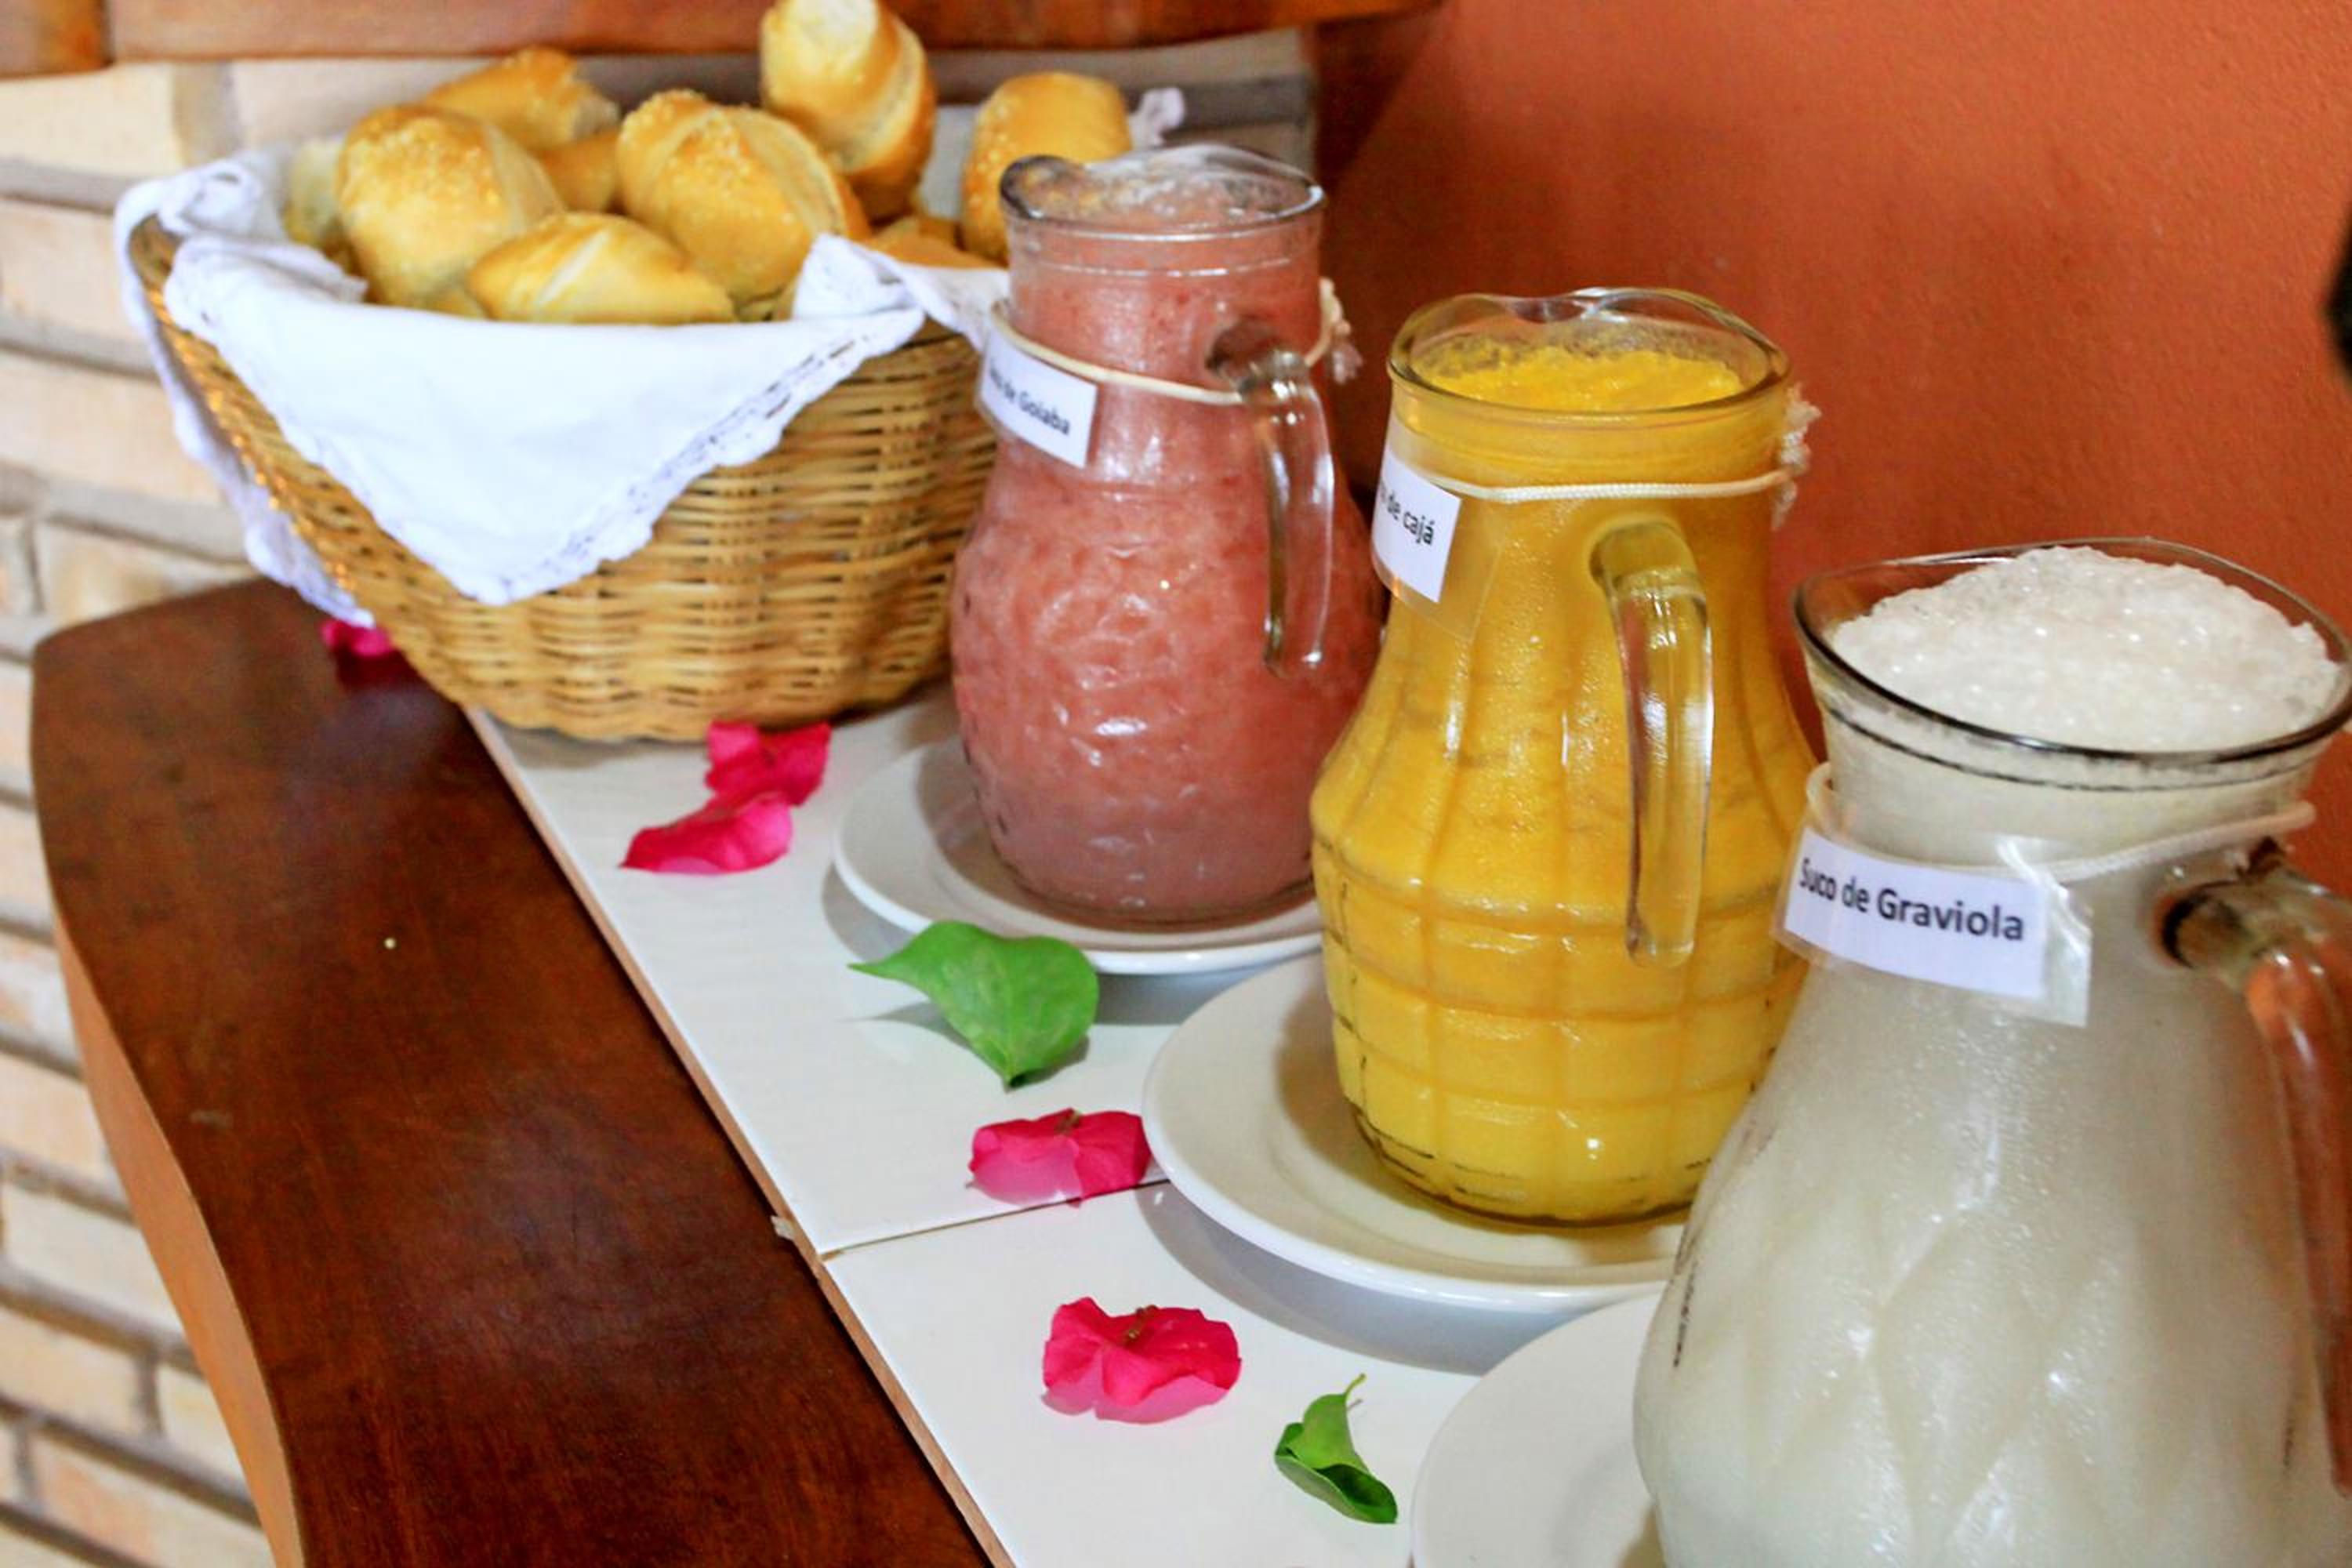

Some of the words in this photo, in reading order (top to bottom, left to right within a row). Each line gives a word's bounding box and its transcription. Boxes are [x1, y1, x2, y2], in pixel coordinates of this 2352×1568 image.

[1020, 391, 1069, 435] Goiaba
[1387, 492, 1401, 521] de
[1403, 512, 1435, 545] cajá
[1799, 858, 1835, 901] Suco
[1842, 876, 1870, 913] de
[1877, 887, 2024, 941] Graviola
